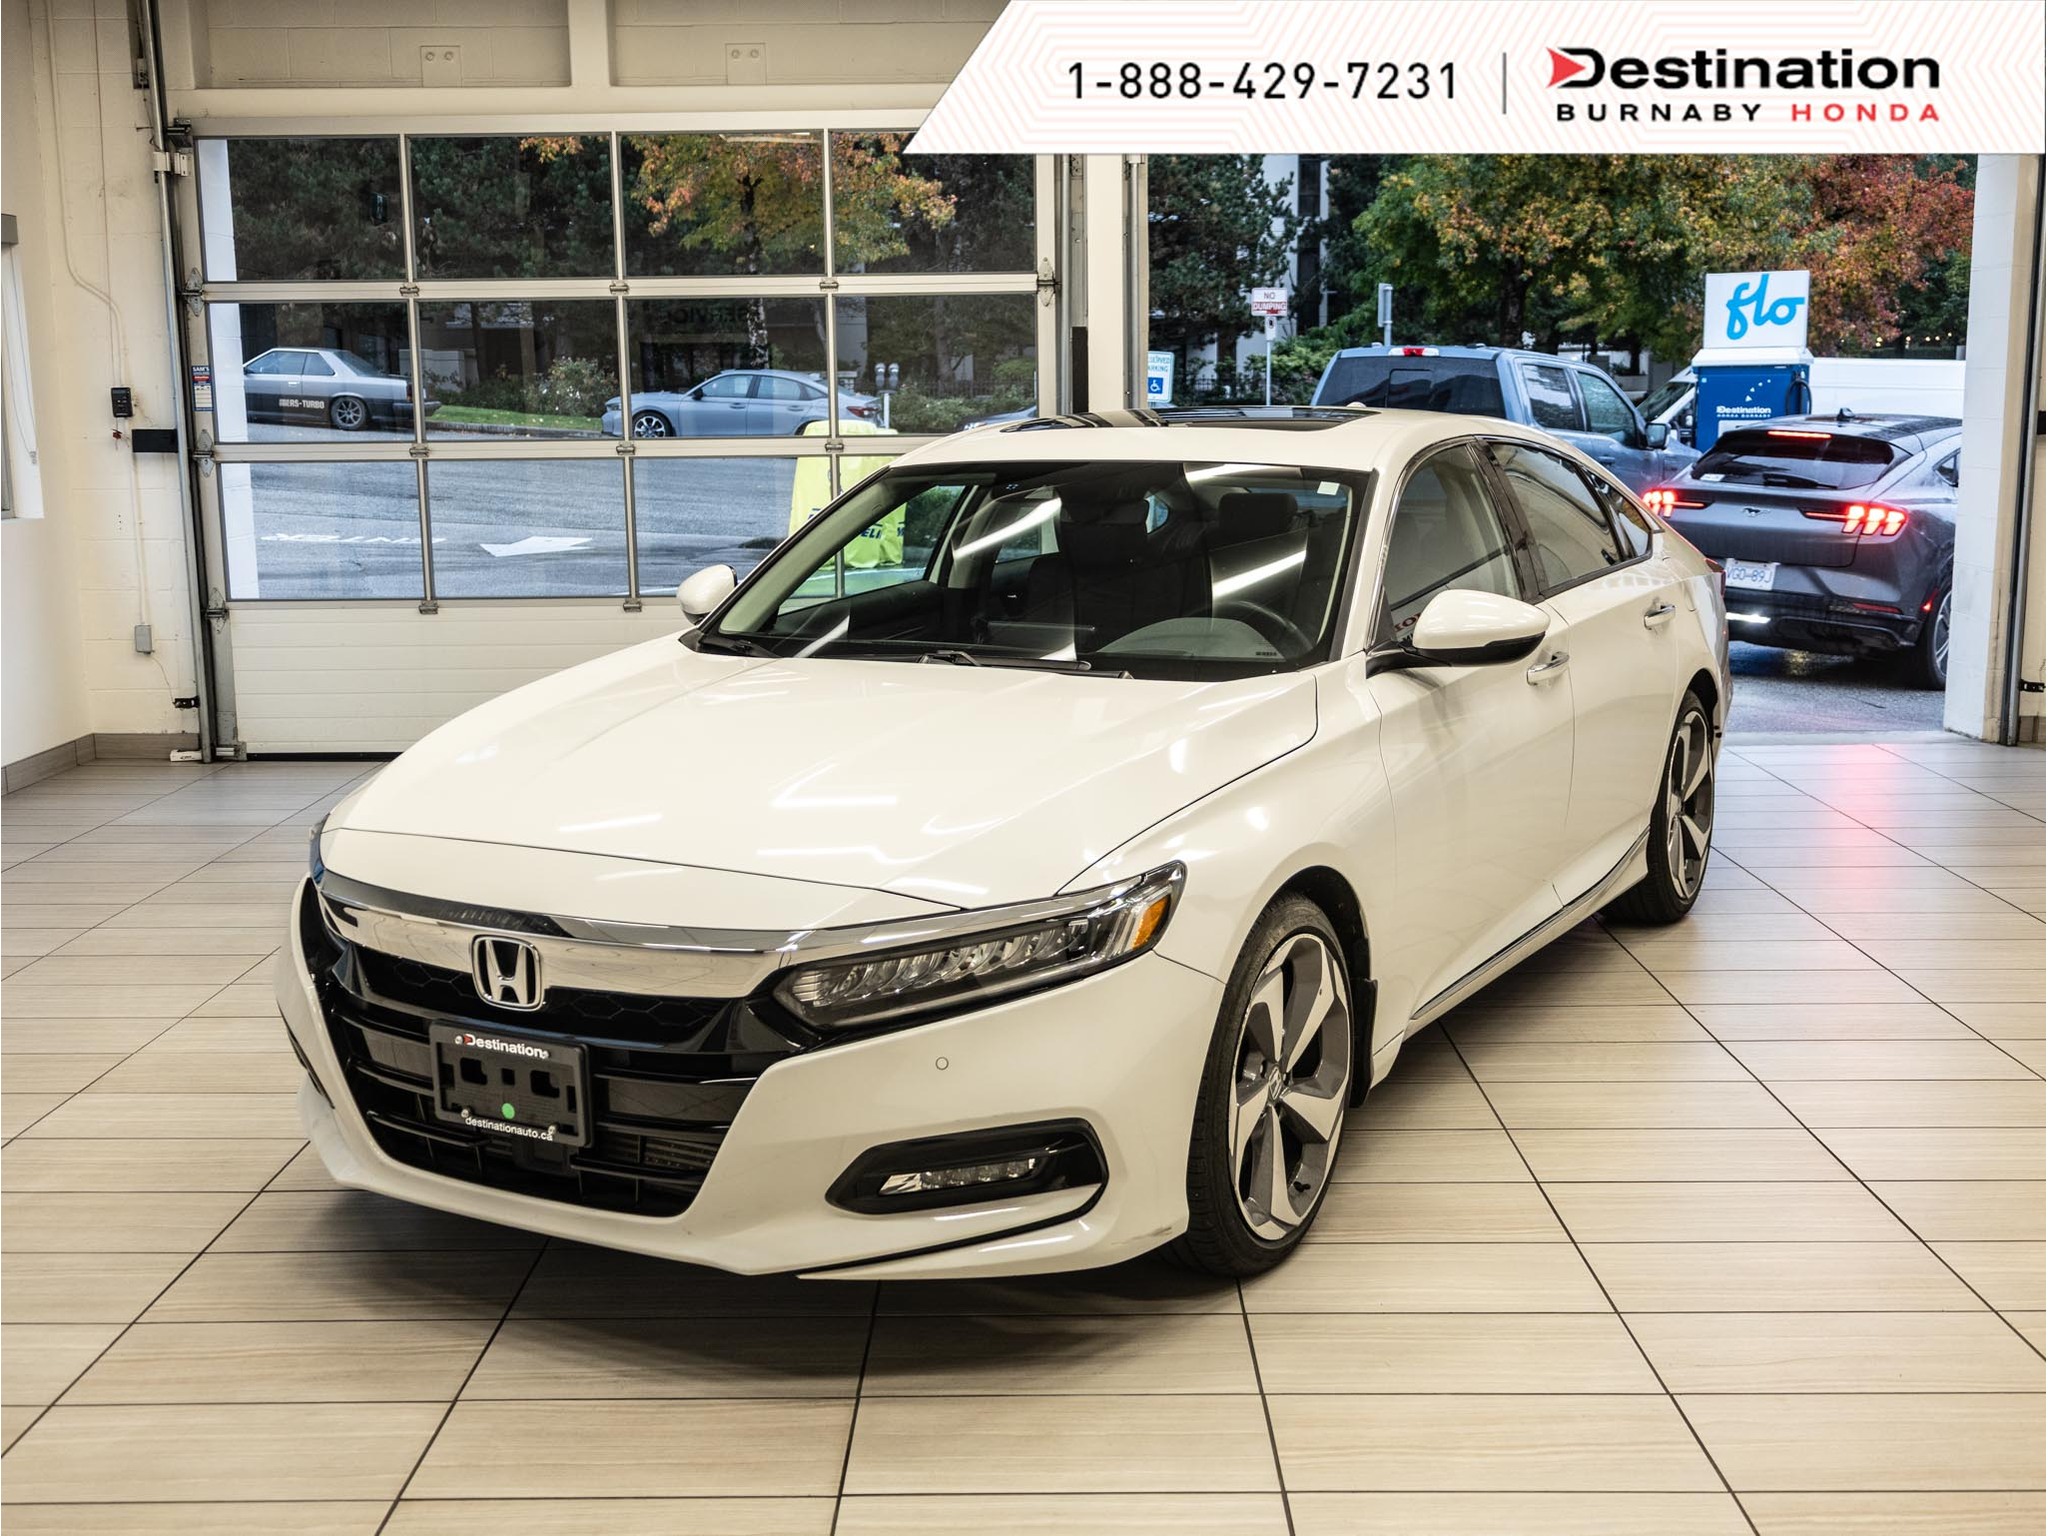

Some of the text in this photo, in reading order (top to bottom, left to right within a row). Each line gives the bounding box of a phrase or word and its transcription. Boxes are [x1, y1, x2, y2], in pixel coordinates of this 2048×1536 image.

[1263, 291, 1275, 300] NO
[1726, 273, 1805, 340] flo
[465, 1115, 554, 1142] destinationauto.ca
